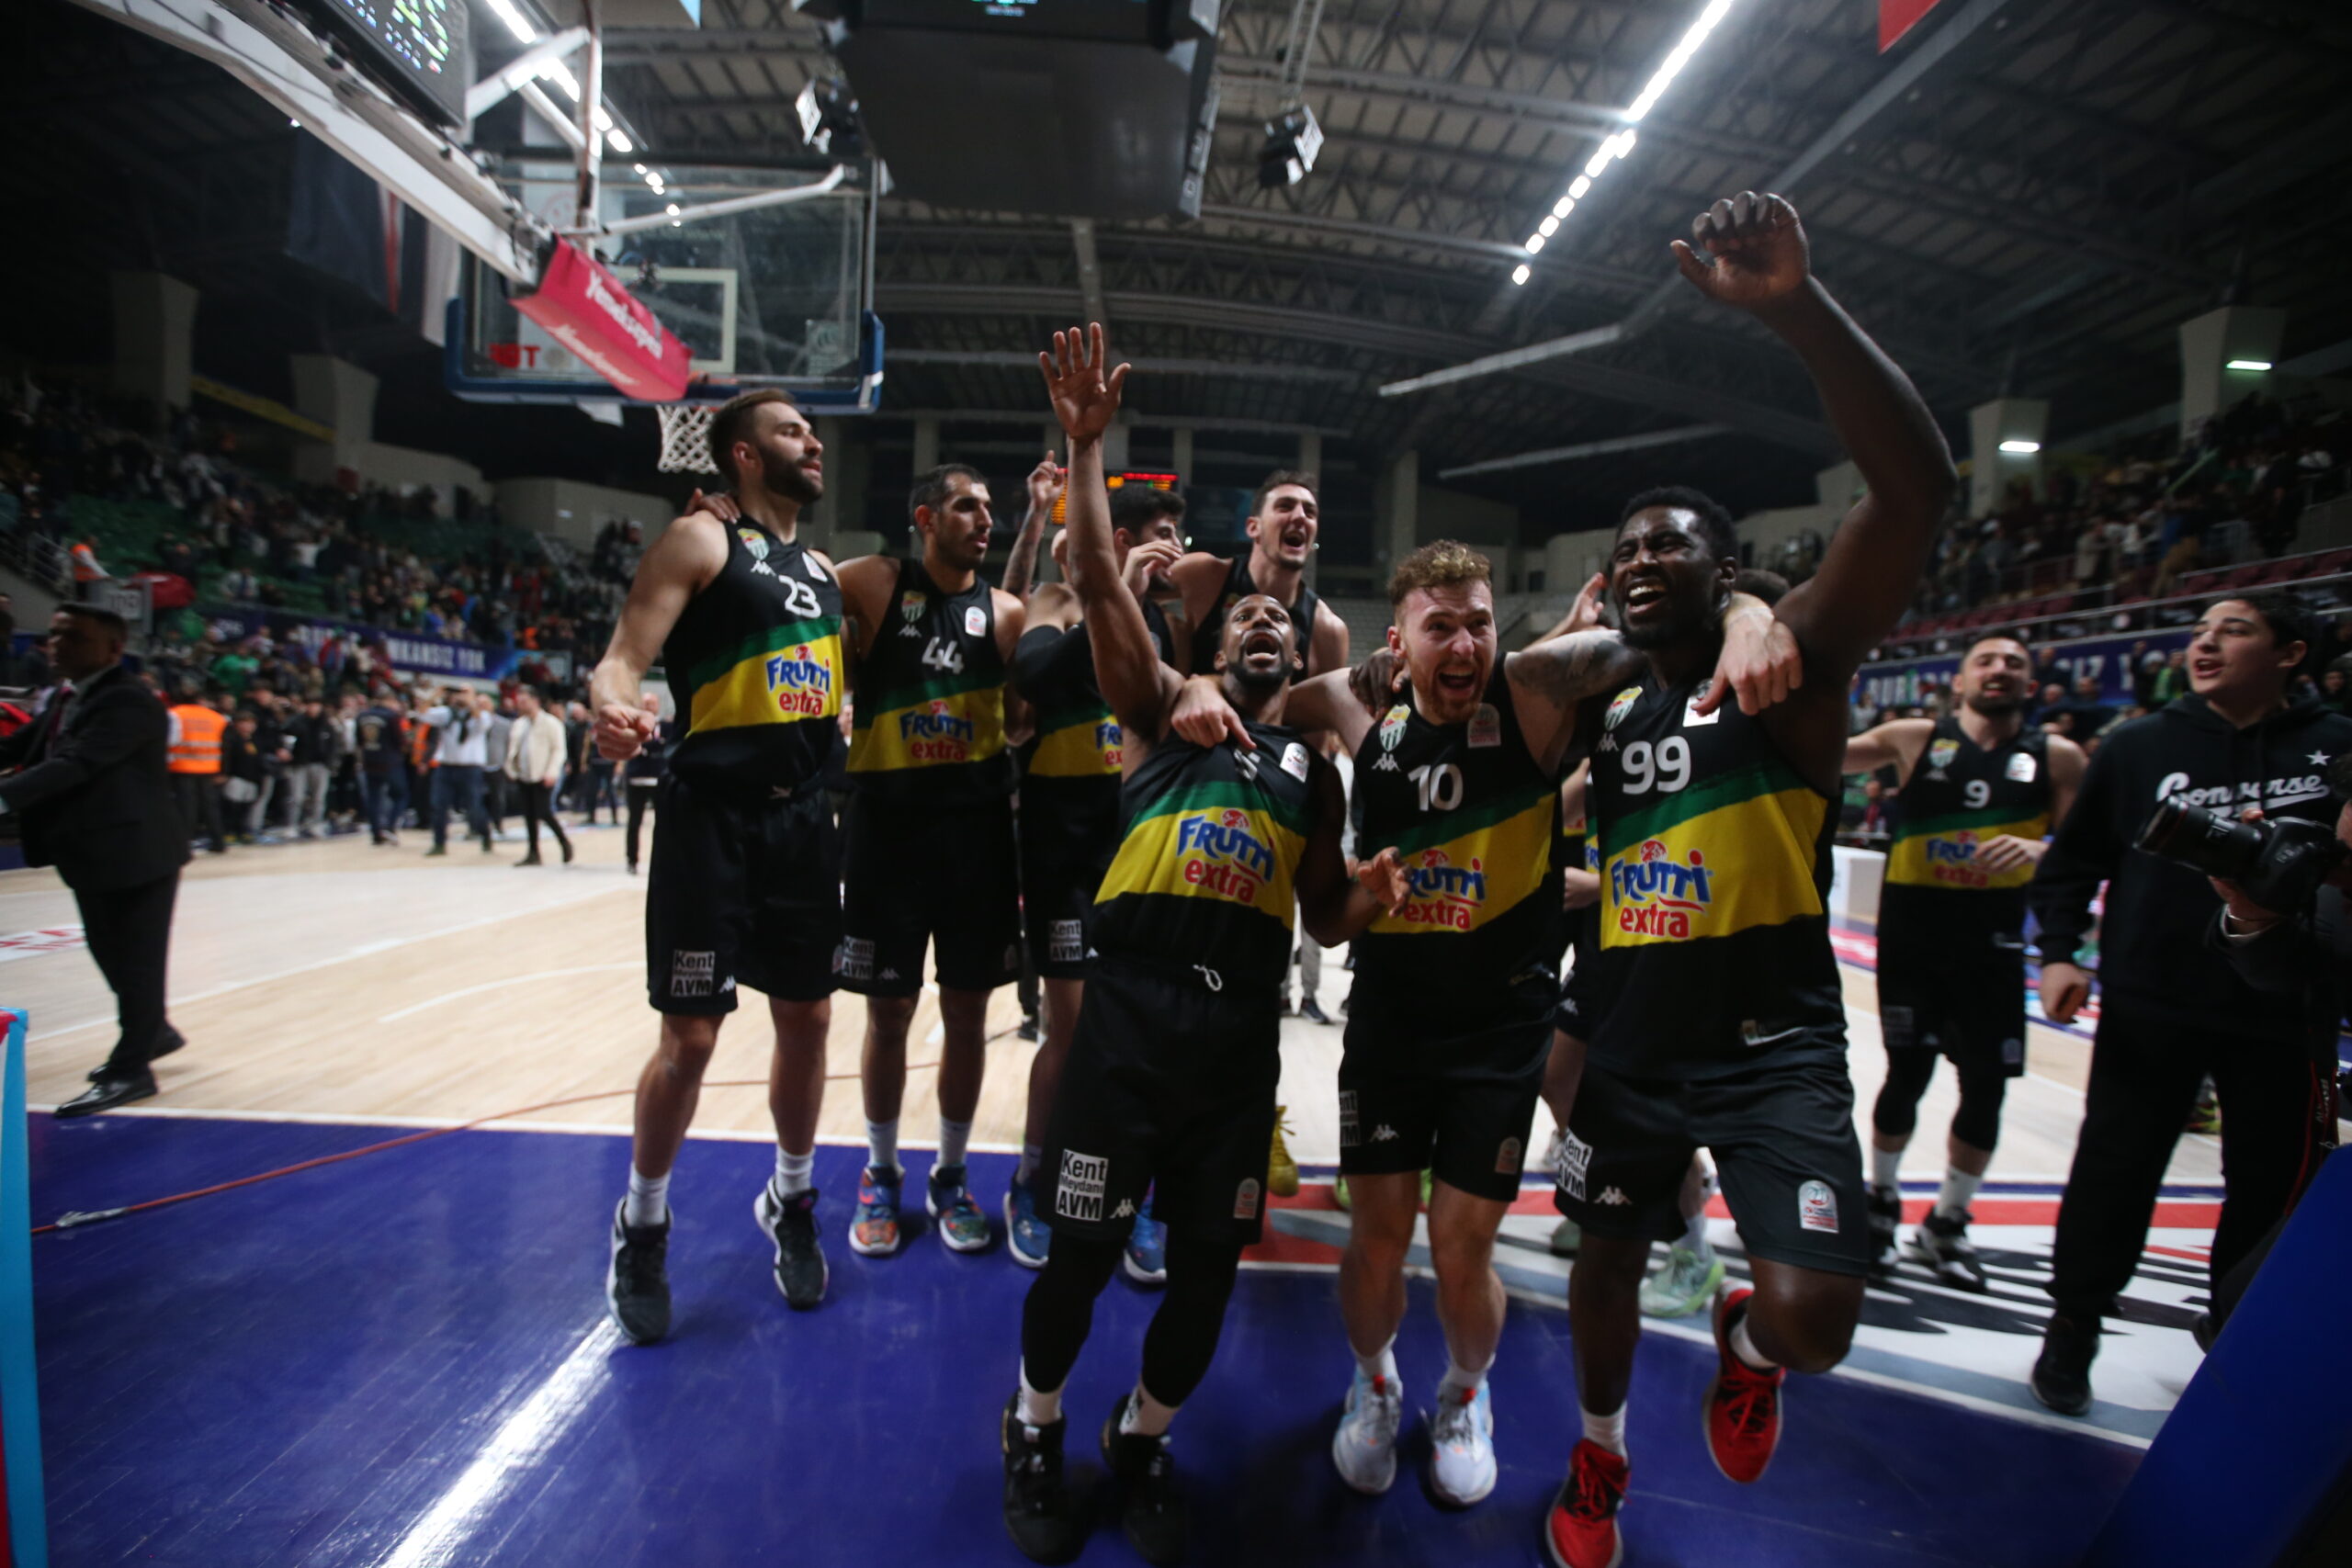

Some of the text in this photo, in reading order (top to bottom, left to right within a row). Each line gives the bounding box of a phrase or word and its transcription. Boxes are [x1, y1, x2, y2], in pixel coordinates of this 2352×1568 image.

[778, 574, 822, 619] 23
[379, 634, 454, 670] MKANSIZ
[922, 636, 964, 675] 44
[779, 691, 824, 716] extra
[911, 740, 968, 761] extra
[1622, 735, 1692, 795] 99
[1408, 763, 1464, 811] 10
[1963, 779, 1990, 808] 9
[1184, 859, 1256, 903] extra
[1403, 901, 1470, 930] extra
[1620, 904, 1690, 939] extra
[675, 952, 714, 969] Kent
[672, 978, 712, 995] AVM
[1062, 1151, 1106, 1181] Kent
[1057, 1190, 1102, 1219] AVM
